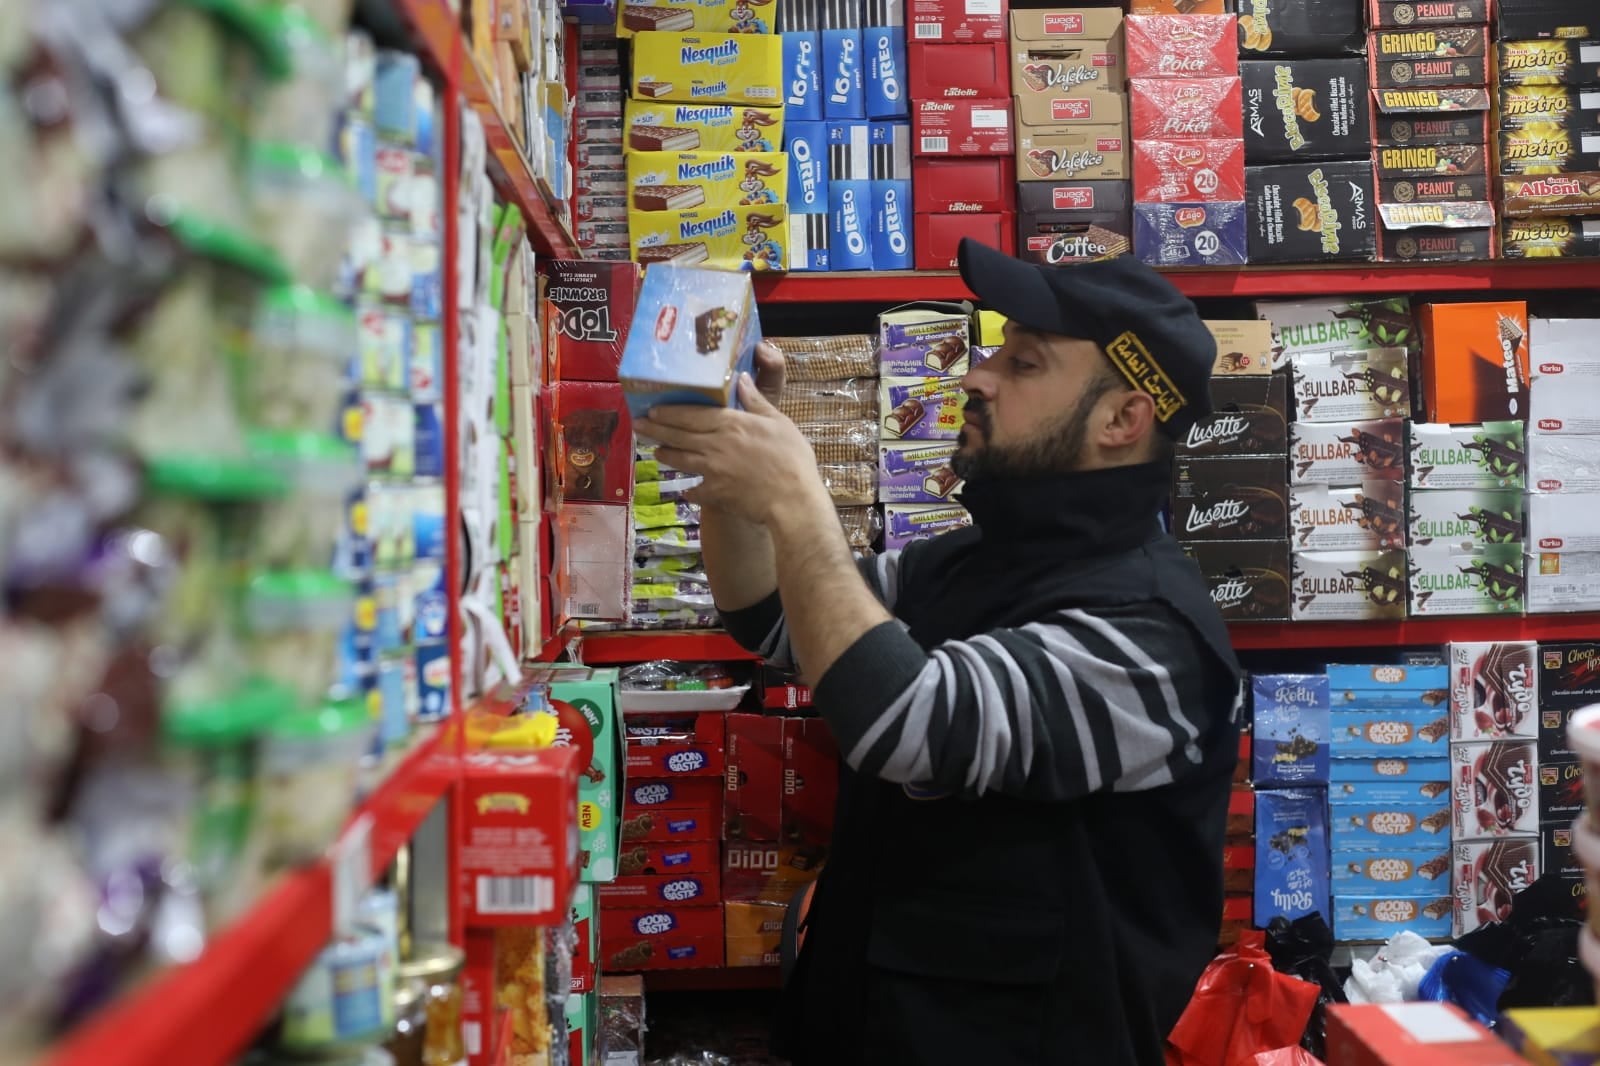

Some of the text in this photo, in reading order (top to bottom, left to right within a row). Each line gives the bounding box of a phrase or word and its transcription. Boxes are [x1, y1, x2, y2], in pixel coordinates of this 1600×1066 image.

[1417, 4, 1454, 16] PEANUT
[1382, 32, 1436, 54] GRINGO
[681, 40, 738, 65] Nesquik
[1507, 49, 1567, 69] metro
[878, 35, 900, 100] OREO
[1159, 54, 1208, 71] Poker
[1415, 62, 1452, 74] PEANUT
[691, 81, 727, 97] Nesquik
[944, 88, 978, 97] tadelle
[1384, 91, 1438, 107] GRINGO
[1509, 95, 1567, 114] metro
[675, 105, 733, 124] Nesquik
[920, 103, 955, 112] tadelle
[1249, 89, 1264, 137] ARMAS
[1163, 117, 1212, 134] Poker
[1415, 121, 1451, 132] PEANUT
[1177, 149, 1201, 161] Lago
[1509, 138, 1568, 158] metro
[1382, 148, 1436, 169] GRINGO
[678, 155, 736, 180] Nesquik
[792, 139, 815, 204] OREO
[1196, 174, 1216, 188] 20
[1417, 182, 1454, 194] PEANUT
[1518, 180, 1580, 197] Albeni
[1055, 191, 1086, 199] sweet
[948, 202, 983, 212] tadelle
[1349, 181, 1366, 230] ARMAS
[843, 189, 864, 254] OREO
[885, 189, 906, 254] OREO
[1181, 210, 1202, 221] Lago
[1389, 206, 1443, 222] GRINGO
[680, 210, 737, 239] Nesquik
[1511, 223, 1569, 241] metro
[1046, 237, 1107, 264] Coffee
[1197, 237, 1217, 251] 20
[1420, 238, 1457, 250] PEANUT
[550, 287, 607, 302] BROWNIE
[907, 322, 961, 334] MILLENNIUM
[1281, 320, 1349, 347] FULLBAR
[1502, 339, 1519, 393] Mateo
[1305, 380, 1356, 398] FULLBAR
[1187, 416, 1249, 448] Lusette
[906, 448, 951, 460] MILLENNIU
[1300, 443, 1351, 461] FULLBAR
[1421, 449, 1472, 465] FULLBAR
[1186, 500, 1249, 532] Lusette
[1302, 509, 1353, 526] FULLBAR
[1419, 521, 1470, 537] FULLBAR
[1303, 578, 1354, 594] FULLBAR
[1420, 574, 1470, 590] FULLBAR
[1568, 649, 1595, 664] Choco
[580, 703, 600, 727] MINT
[1369, 722, 1407, 734] BOOM
[1370, 733, 1407, 744] BASTIC
[669, 752, 703, 763] BOOM
[668, 761, 703, 772] BASTIC
[634, 785, 669, 796] BOOM
[636, 794, 668, 805] BASTIC
[581, 804, 591, 828] NEW
[1372, 813, 1410, 824] BOOM
[1374, 823, 1410, 835] BASTIC
[1370, 860, 1408, 871] BOOM
[1370, 869, 1406, 880] BASTIC
[663, 880, 698, 892] BOOM
[664, 890, 697, 901] BASTIC
[1271, 891, 1312, 911] Rolly
[1375, 901, 1413, 912] BOOM
[637, 914, 672, 925] BOOM
[1375, 911, 1412, 922] BASTIC
[638, 923, 672, 934] BASTIC
